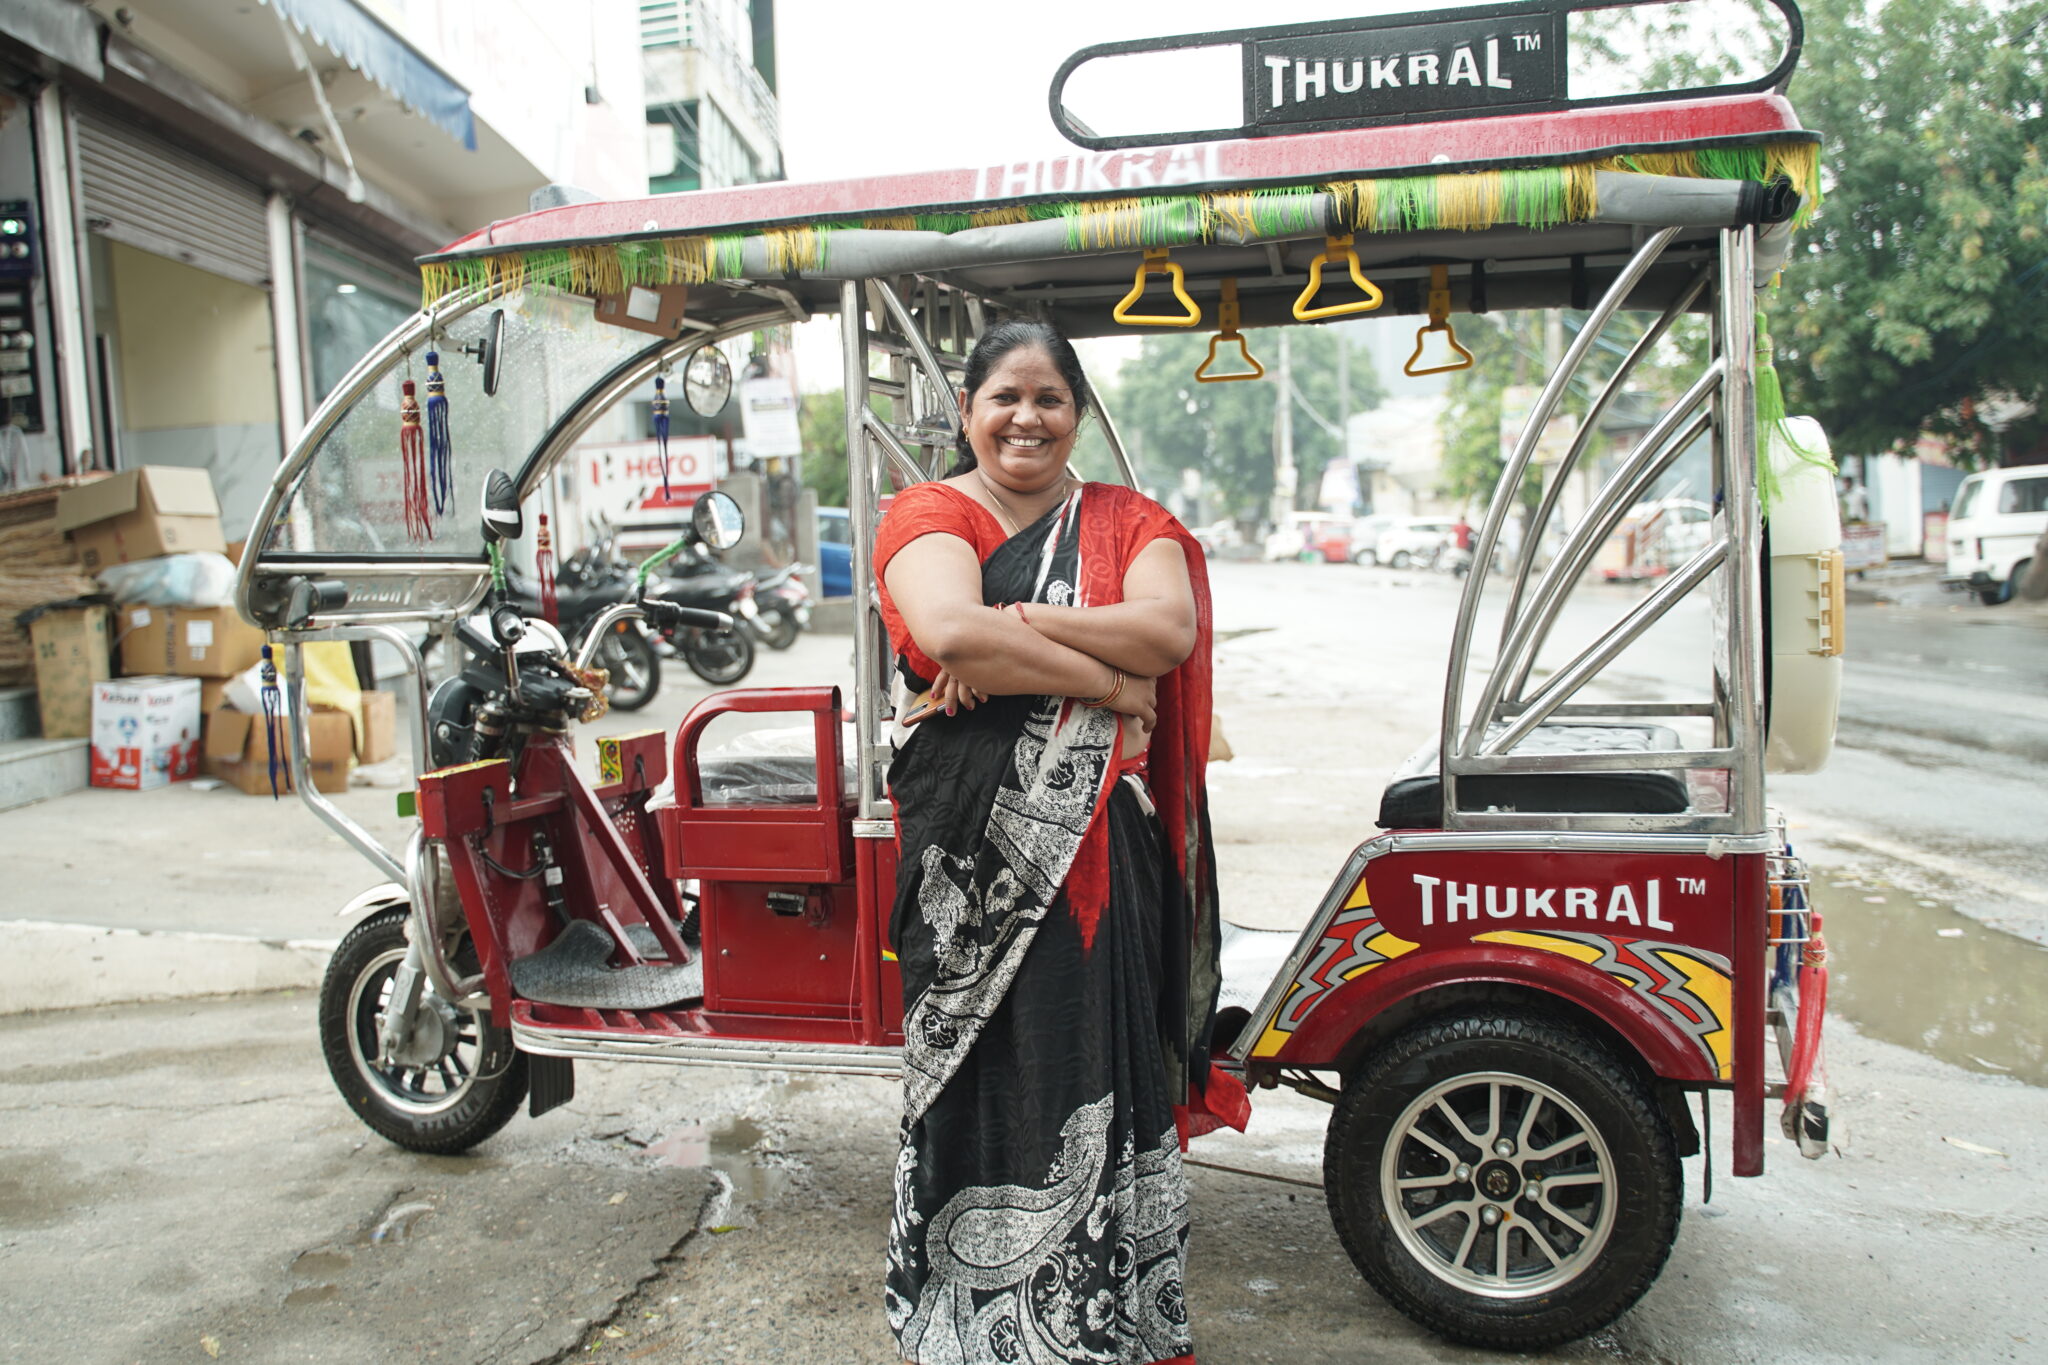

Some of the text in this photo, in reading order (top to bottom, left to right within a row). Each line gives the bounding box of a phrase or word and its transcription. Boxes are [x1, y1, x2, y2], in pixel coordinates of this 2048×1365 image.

[1264, 34, 1541, 108] THUKRAL TM
[1413, 873, 1706, 932] THUKRAL TM
